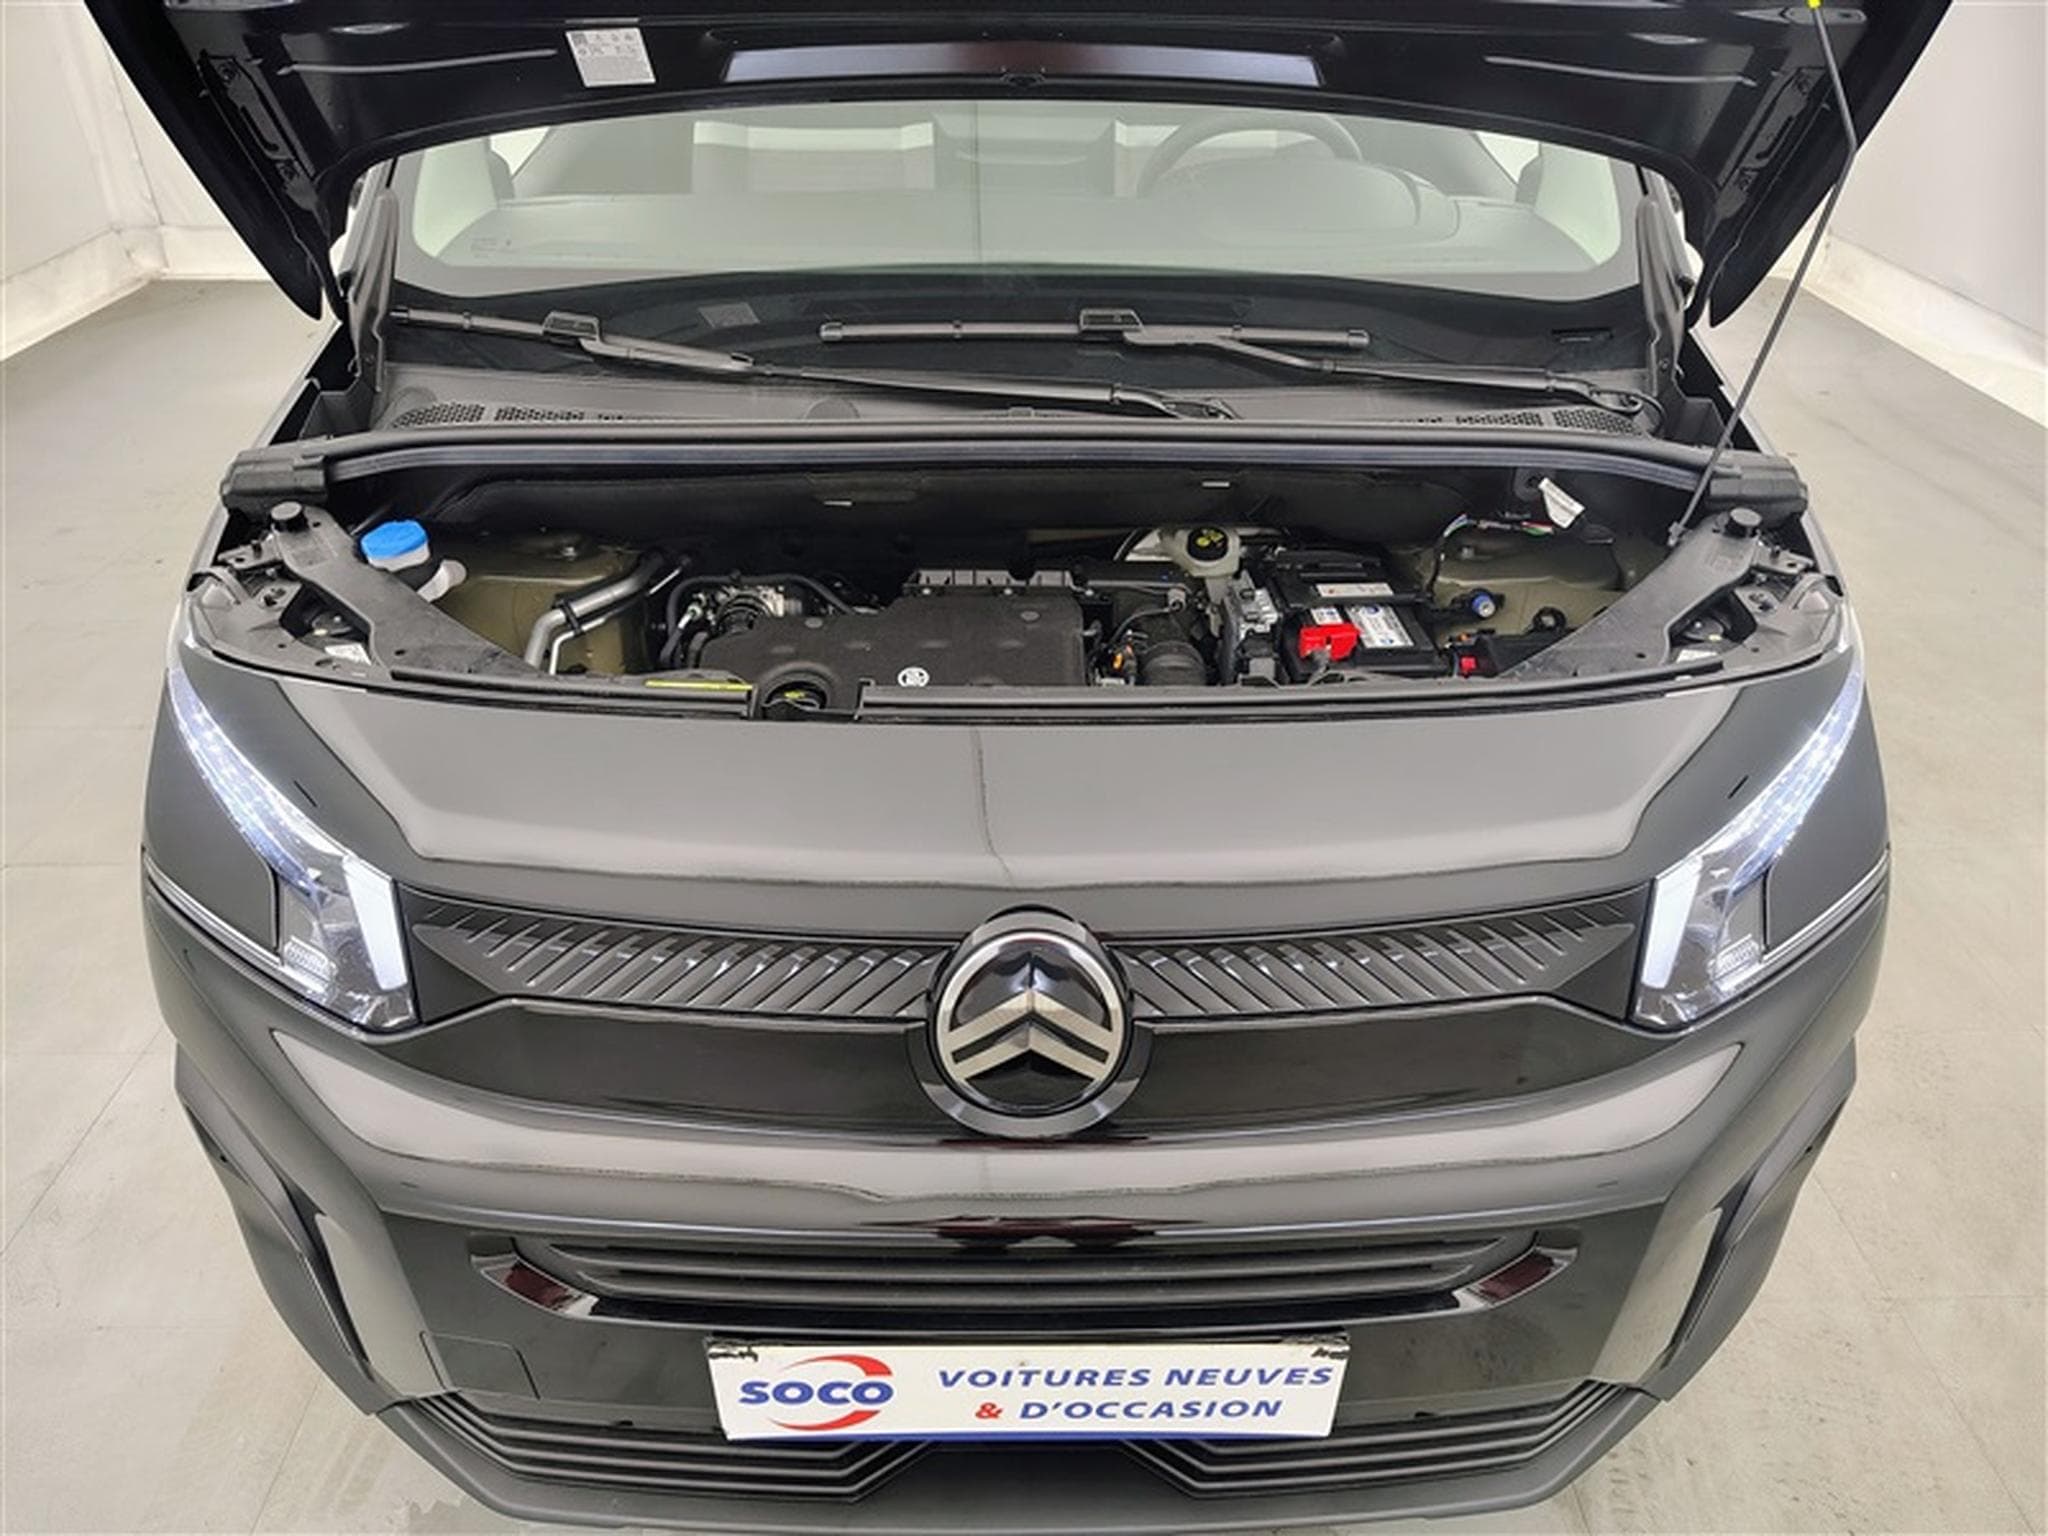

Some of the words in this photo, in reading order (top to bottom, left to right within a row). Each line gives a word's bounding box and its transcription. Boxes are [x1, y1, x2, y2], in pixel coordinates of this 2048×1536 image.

[938, 1368, 1150, 1388] VOITURES
[1164, 1366, 1333, 1387] NEUVES
[739, 1380, 894, 1406] SOCO
[975, 1402, 1003, 1421] &
[1019, 1400, 1283, 1421] D'OCCASION
